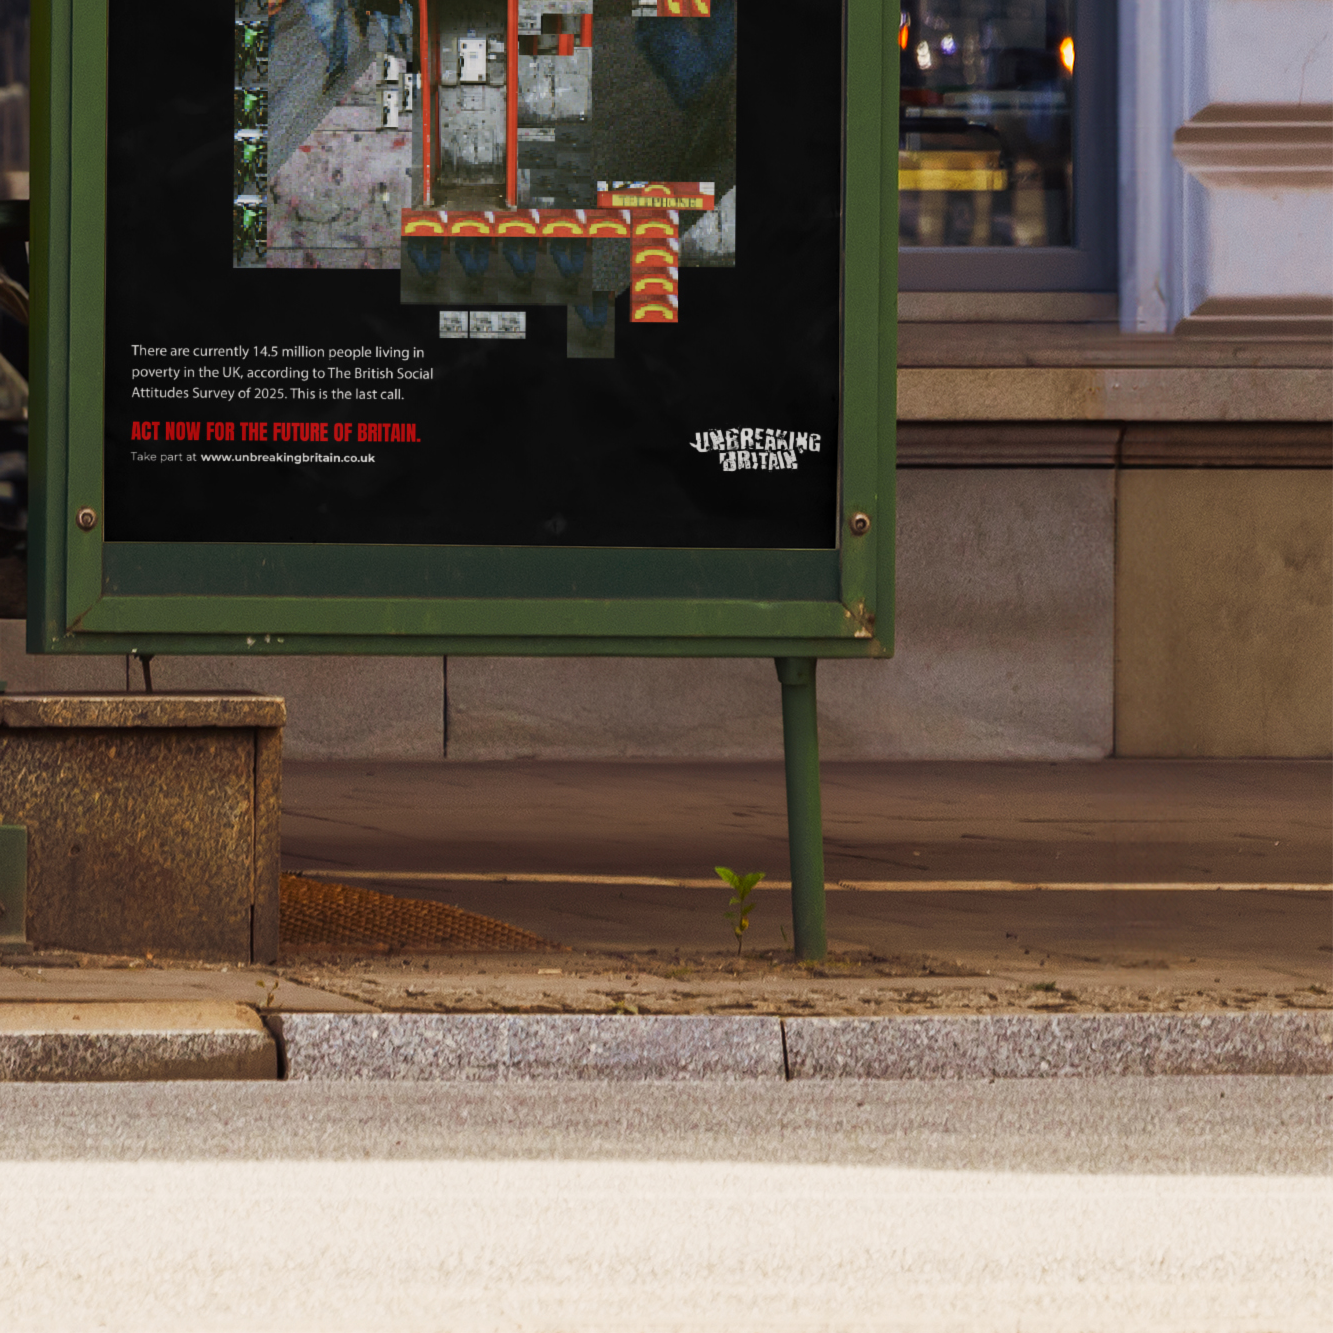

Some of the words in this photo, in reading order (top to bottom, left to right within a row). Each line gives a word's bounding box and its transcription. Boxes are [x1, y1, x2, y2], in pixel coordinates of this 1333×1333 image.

[130, 344, 168, 357] There
[170, 347, 190, 357] are
[192, 344, 250, 360] currently
[253, 345, 279, 358] 14.5
[281, 345, 325, 358] million
[328, 345, 372, 361] people
[375, 345, 410, 361] living
[413, 346, 425, 358] in
[131, 367, 181, 381] poverty
[183, 366, 195, 378] in
[198, 365, 220, 378] the
[222, 366, 244, 380] UK,
[246, 366, 309, 382] according
[312, 367, 326, 379] to
[327, 366, 352, 379] The
[354, 367, 394, 380] British
[396, 367, 434, 380] Social
[131, 386, 189, 399] Attitudes
[192, 386, 235, 402] Survey
[237, 386, 252, 399] of
[254, 387, 288, 399] 2025.
[289, 387, 316, 400] This
[318, 388, 328, 400] is
[331, 387, 353, 400] the
[355, 388, 378, 400] last
[380, 388, 405, 400] call.
[130, 420, 161, 441] ACT
[165, 421, 201, 441] NOW
[206, 421, 235, 442] FOR
[239, 421, 268, 442] THE
[272, 422, 329, 442] FUTURE
[333, 422, 353, 442] OF
[357, 422, 422, 443] BRITAIN.
[689, 427, 822, 455] UNBREAKING
[130, 451, 157, 462] Take
[160, 453, 183, 464] part
[186, 453, 197, 462] at
[200, 452, 376, 465] www.unbreakingbritain.co.uk
[718, 449, 799, 472] BRITAIN
